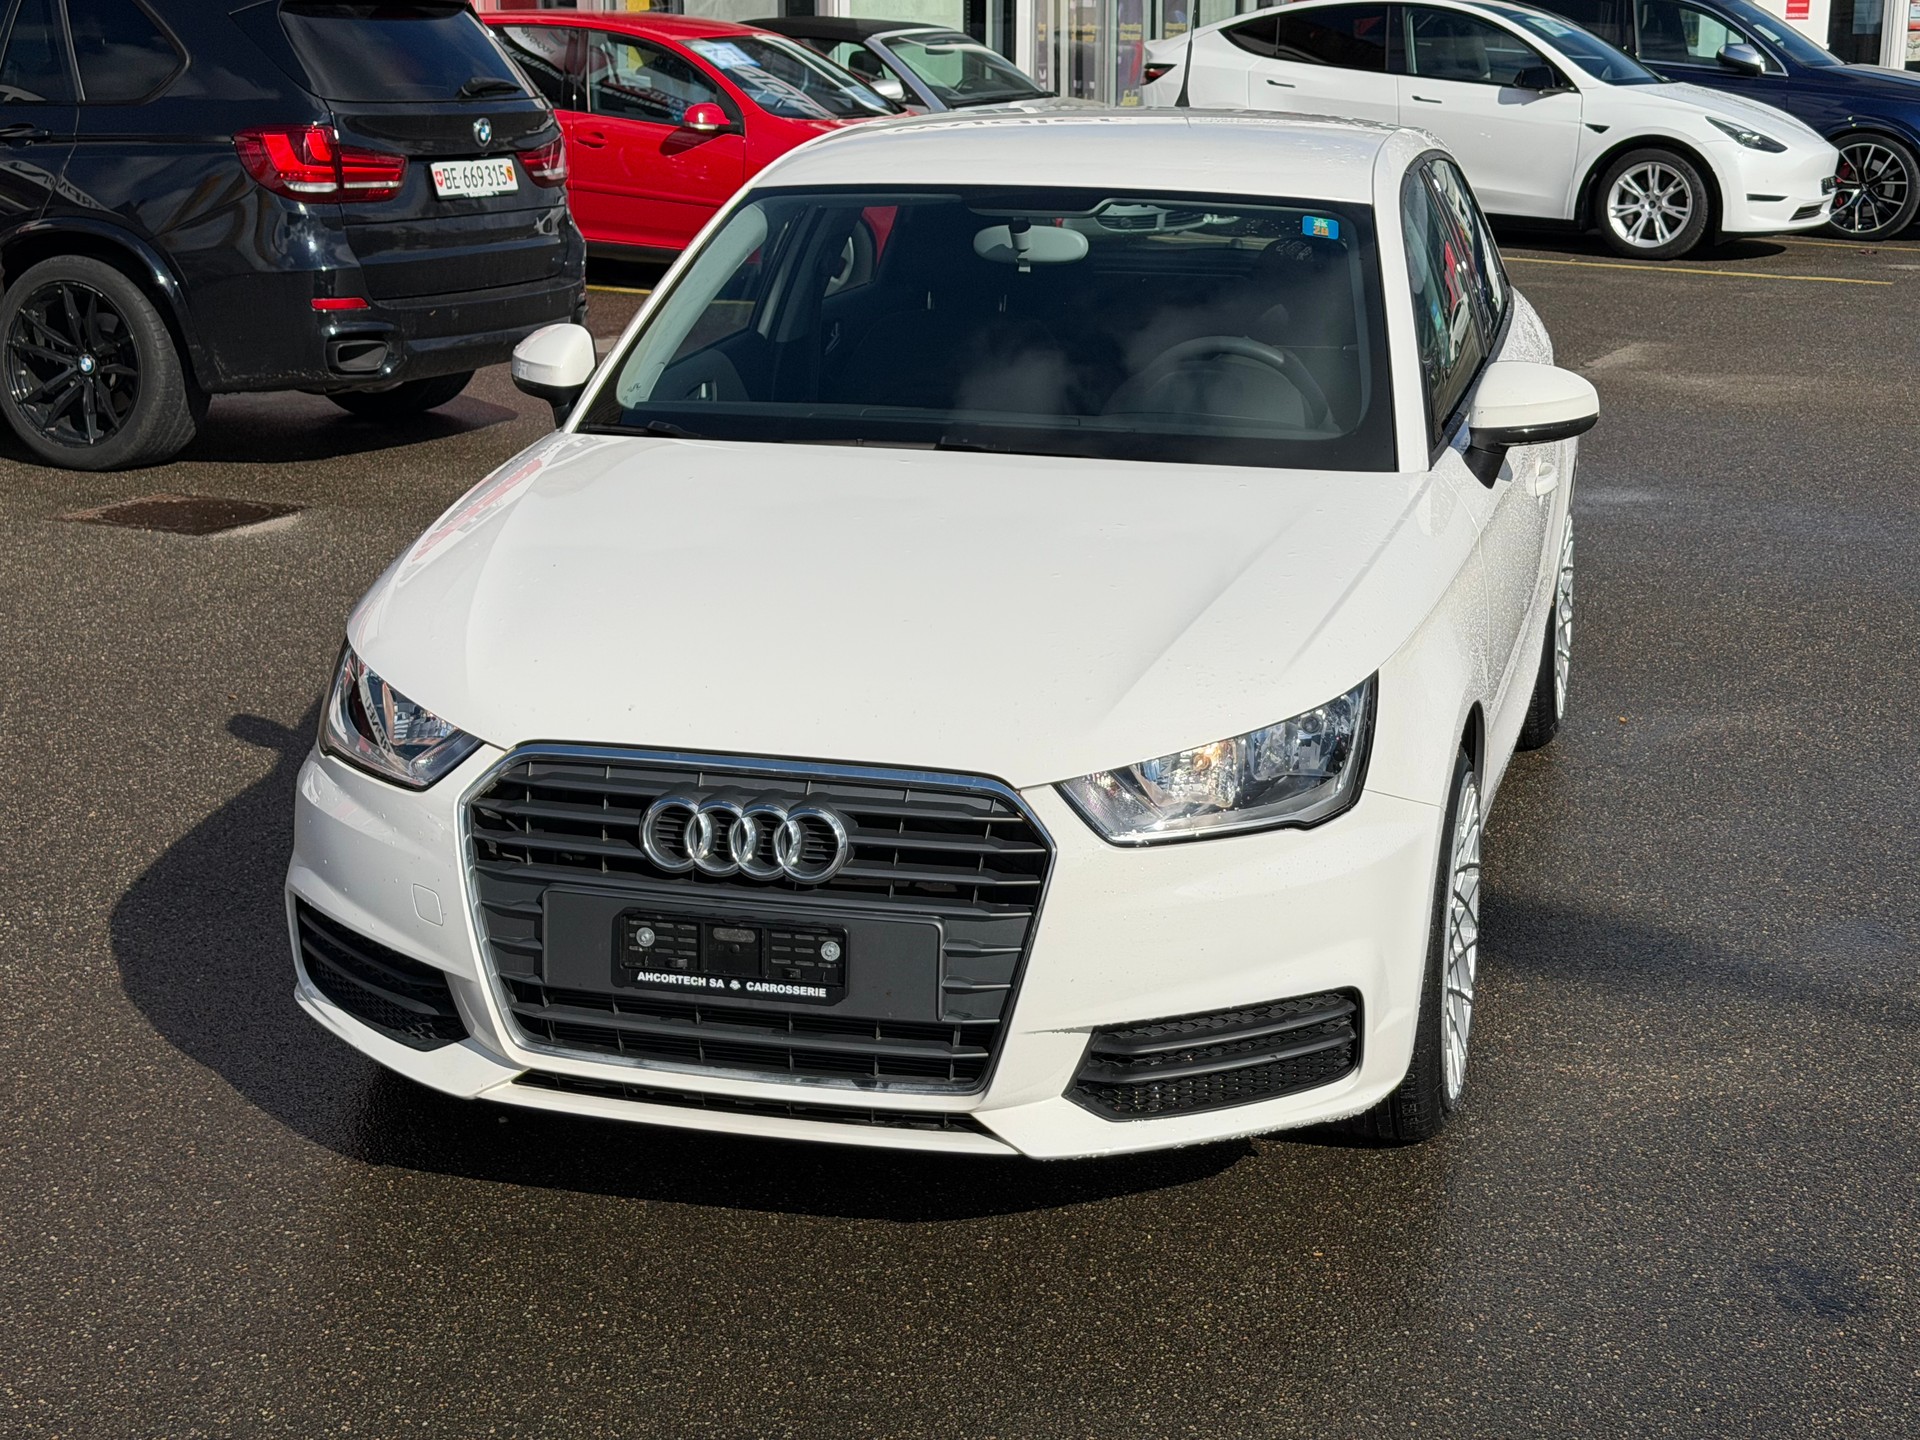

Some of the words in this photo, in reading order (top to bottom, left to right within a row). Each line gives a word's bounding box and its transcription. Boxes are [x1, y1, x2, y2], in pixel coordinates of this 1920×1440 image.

[637, 971, 707, 987] AHCORTECH
[709, 978, 726, 989] SA
[745, 981, 827, 998] CARROSSERIE
